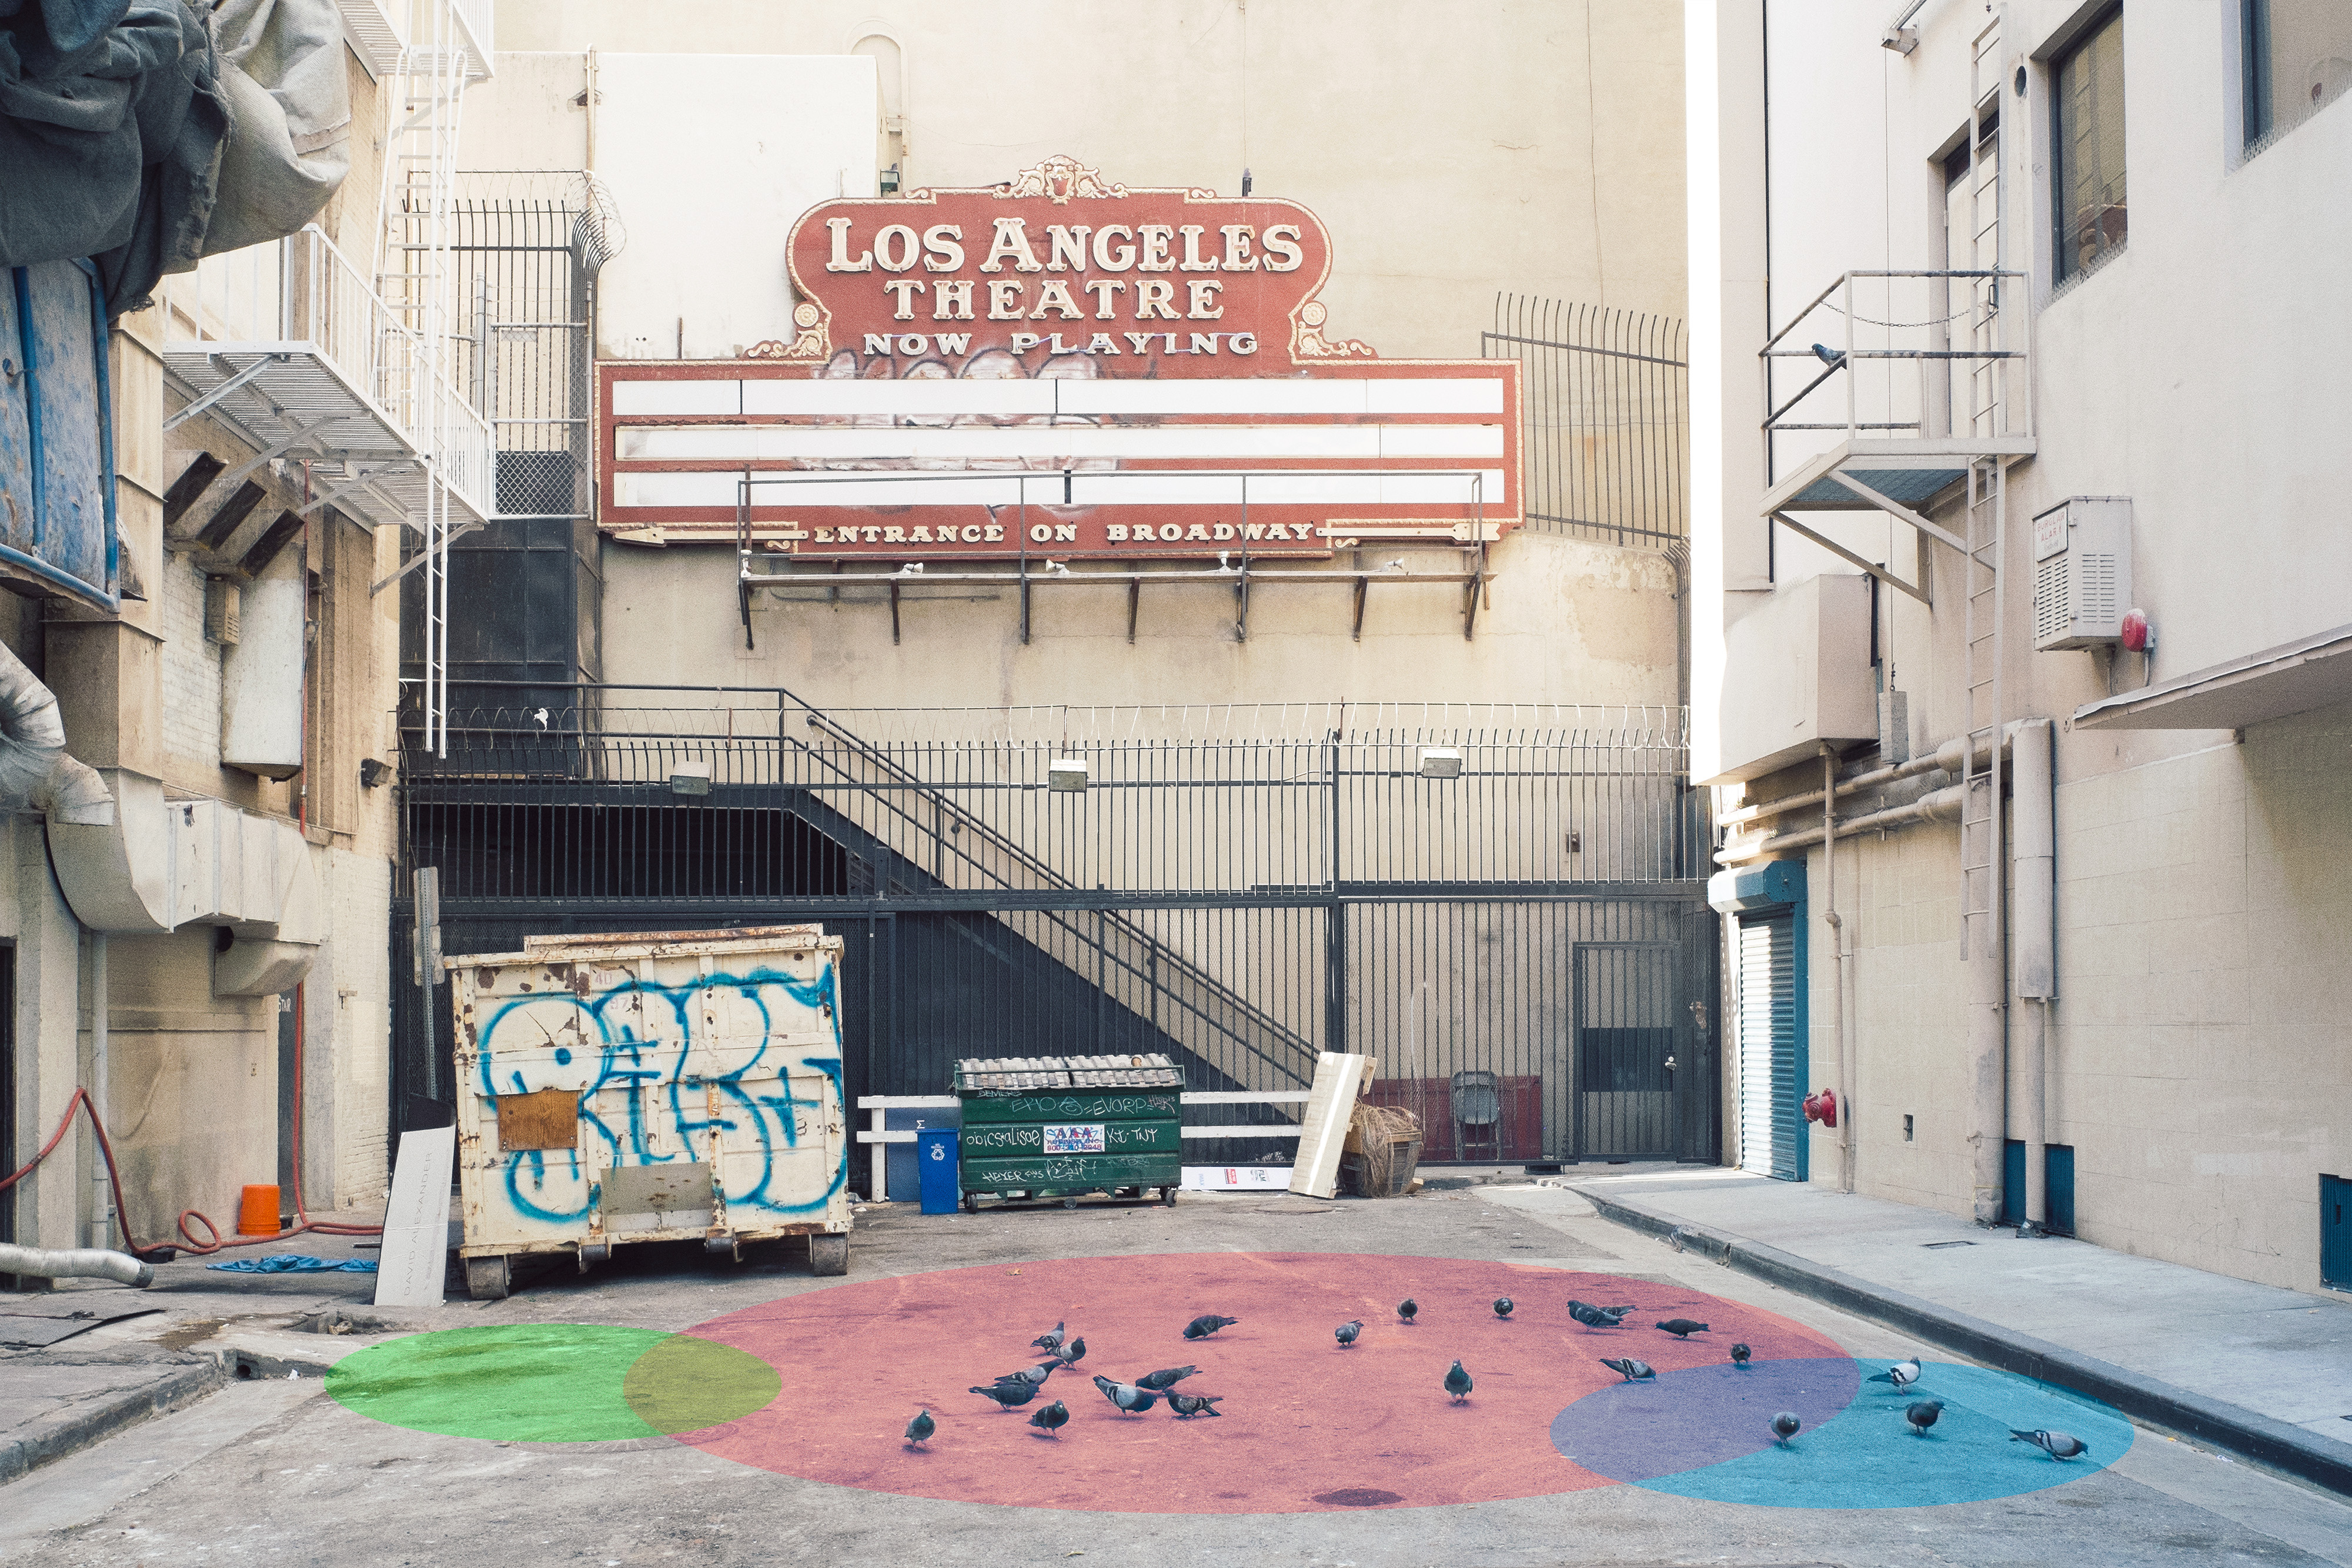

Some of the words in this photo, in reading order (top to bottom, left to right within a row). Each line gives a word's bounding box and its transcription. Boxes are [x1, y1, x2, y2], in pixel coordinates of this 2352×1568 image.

[826, 217, 964, 273] LOS
[979, 216, 1304, 273] ANGELES
[883, 279, 1224, 320] THEATRE
[863, 332, 973, 355] NOW
[1011, 331, 1258, 355] PLAYING
[814, 524, 1005, 544] ENTRANCE
[1030, 524, 1077, 543] ON
[1107, 523, 1315, 542] BROADWAY
[1257, 1169, 1266, 1182] FILM
[404, 1250, 416, 1296] DAVID
[412, 1152, 432, 1243] ALEXANDER
